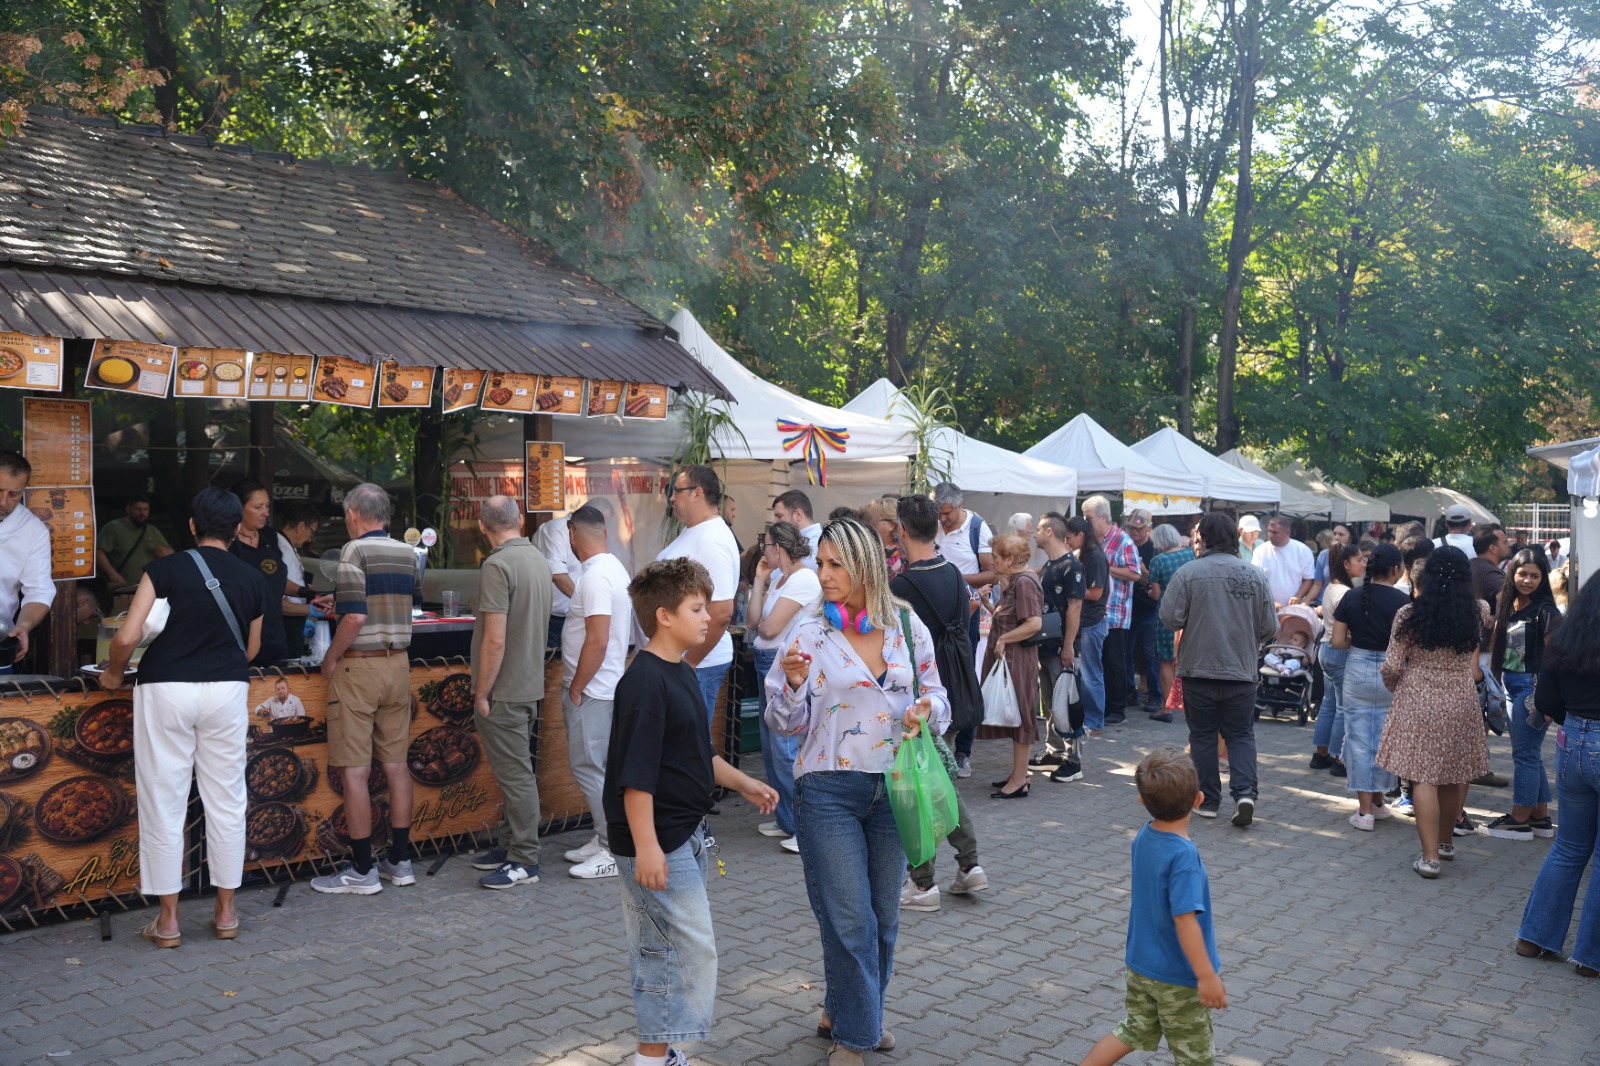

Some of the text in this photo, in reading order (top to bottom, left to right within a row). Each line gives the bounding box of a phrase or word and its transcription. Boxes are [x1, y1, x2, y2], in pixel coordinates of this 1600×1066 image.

[411, 800, 447, 831] Andy
[110, 838, 130, 859] By
[62, 856, 124, 894] Andy
[595, 863, 615, 876] JUST
